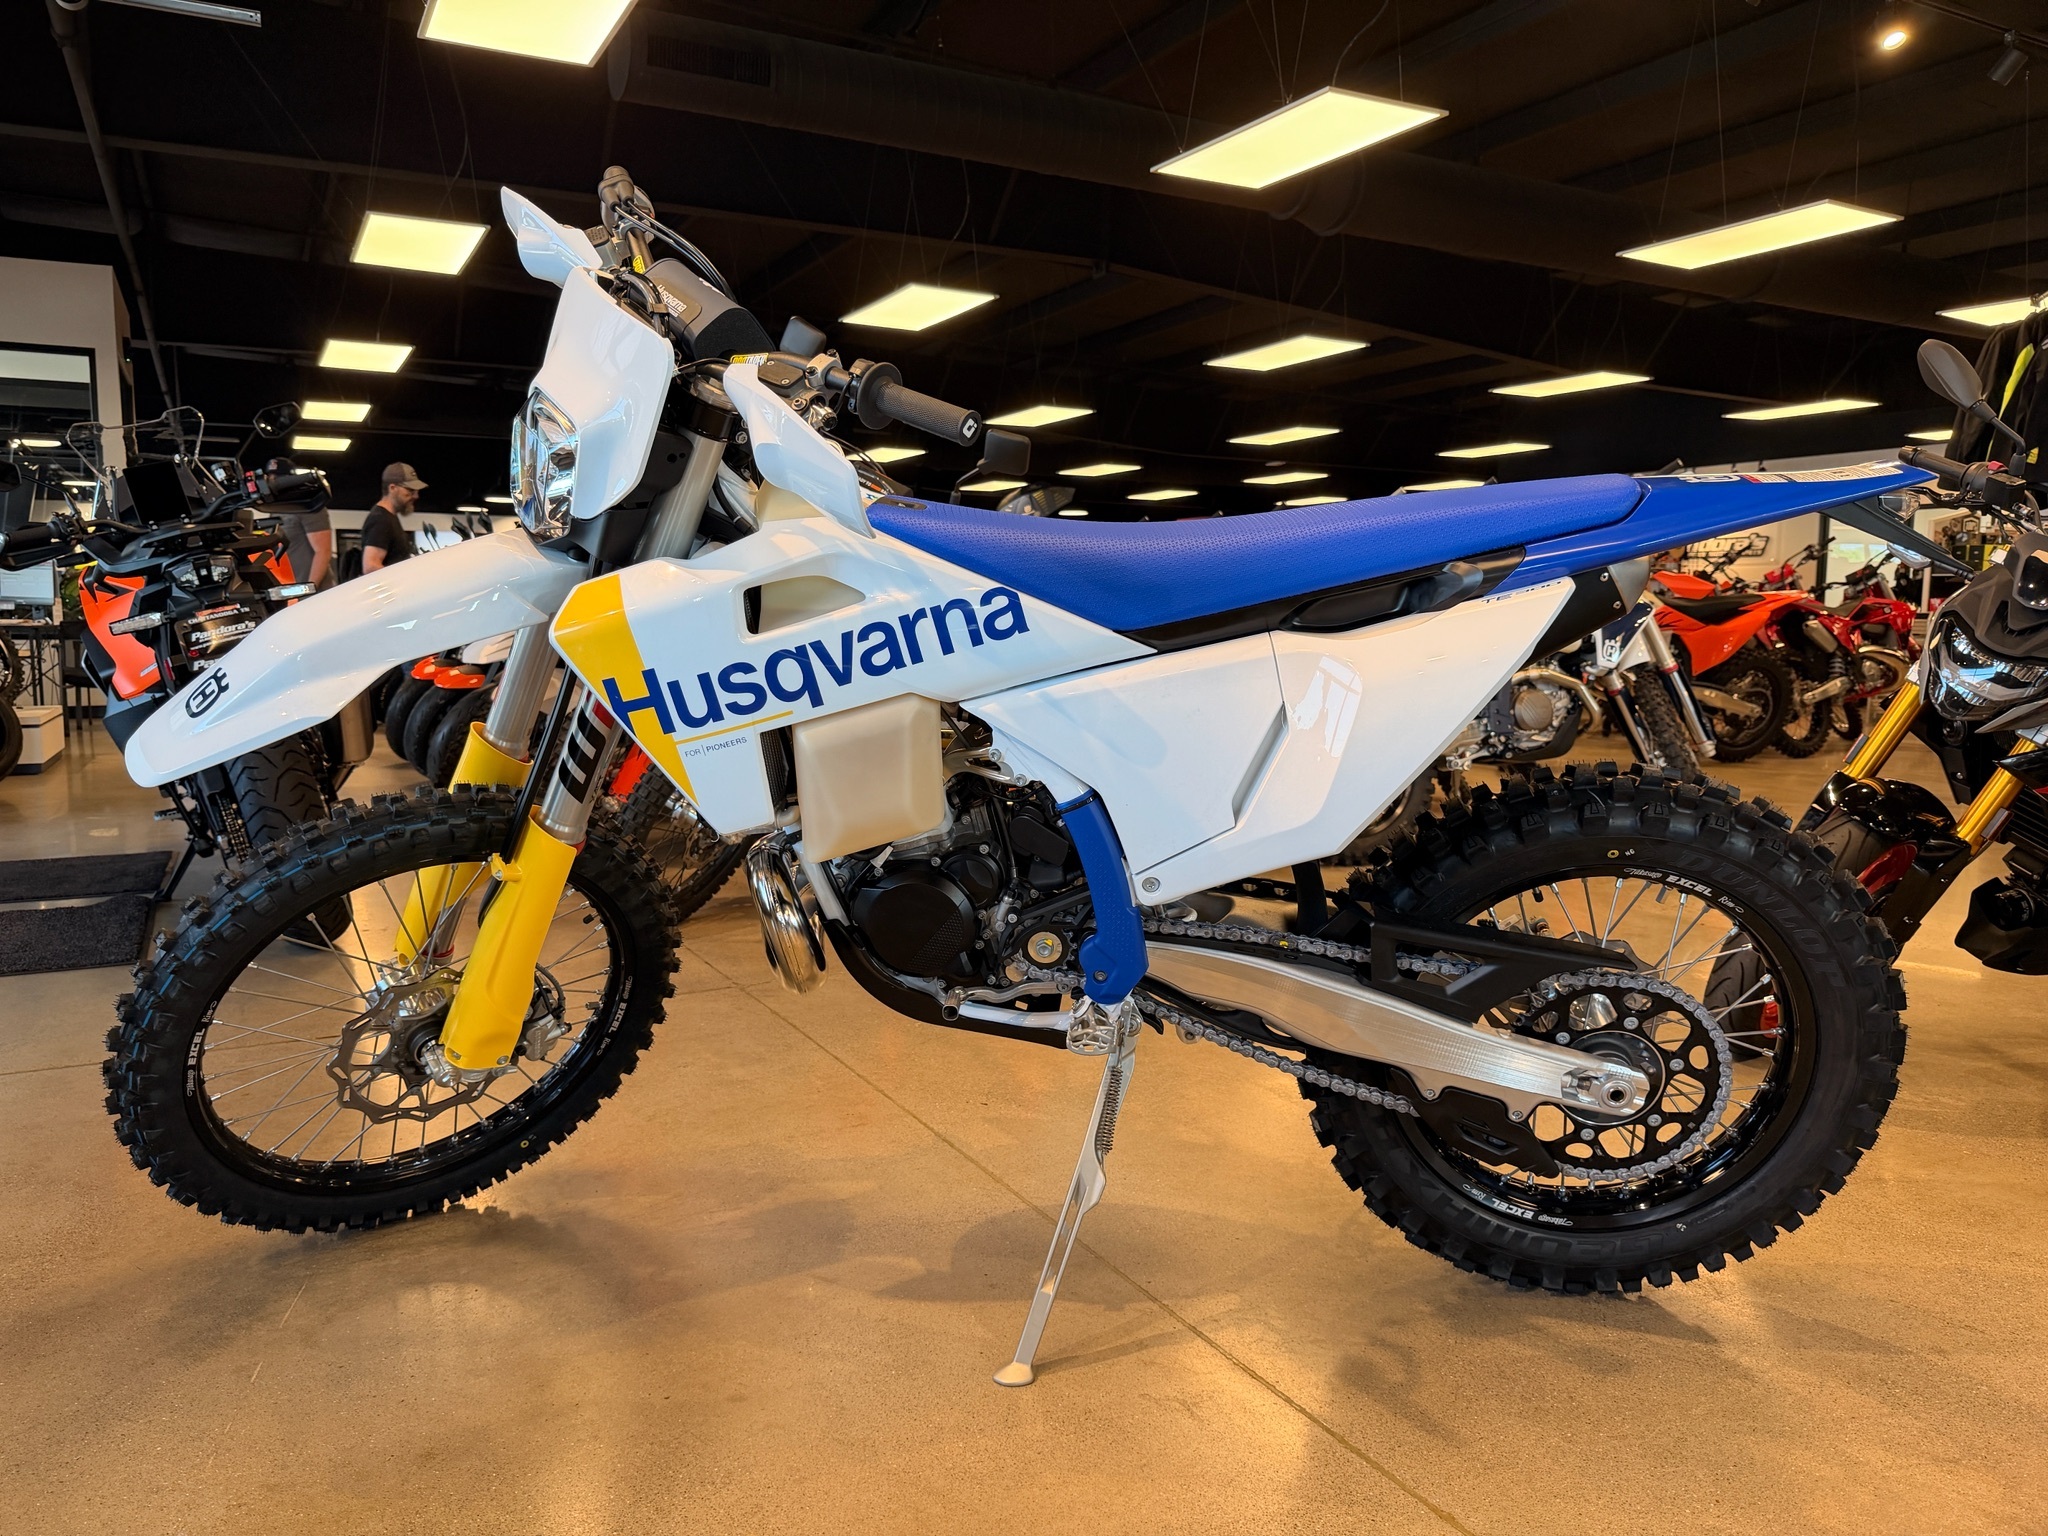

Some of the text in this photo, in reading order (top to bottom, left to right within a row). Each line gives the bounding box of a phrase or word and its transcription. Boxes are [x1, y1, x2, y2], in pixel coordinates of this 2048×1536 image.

[191, 620, 256, 642] Pandora's
[602, 586, 1030, 735] Husqvarna
[684, 736, 748, 758] FOR PIONEERS
[1666, 874, 1713, 897] EXCEL
[1670, 850, 1846, 987] DUNLOP
[608, 1002, 628, 1033] EXCEL
[187, 1028, 206, 1066] EXCEL
[1492, 1197, 1535, 1220] EXCEL
